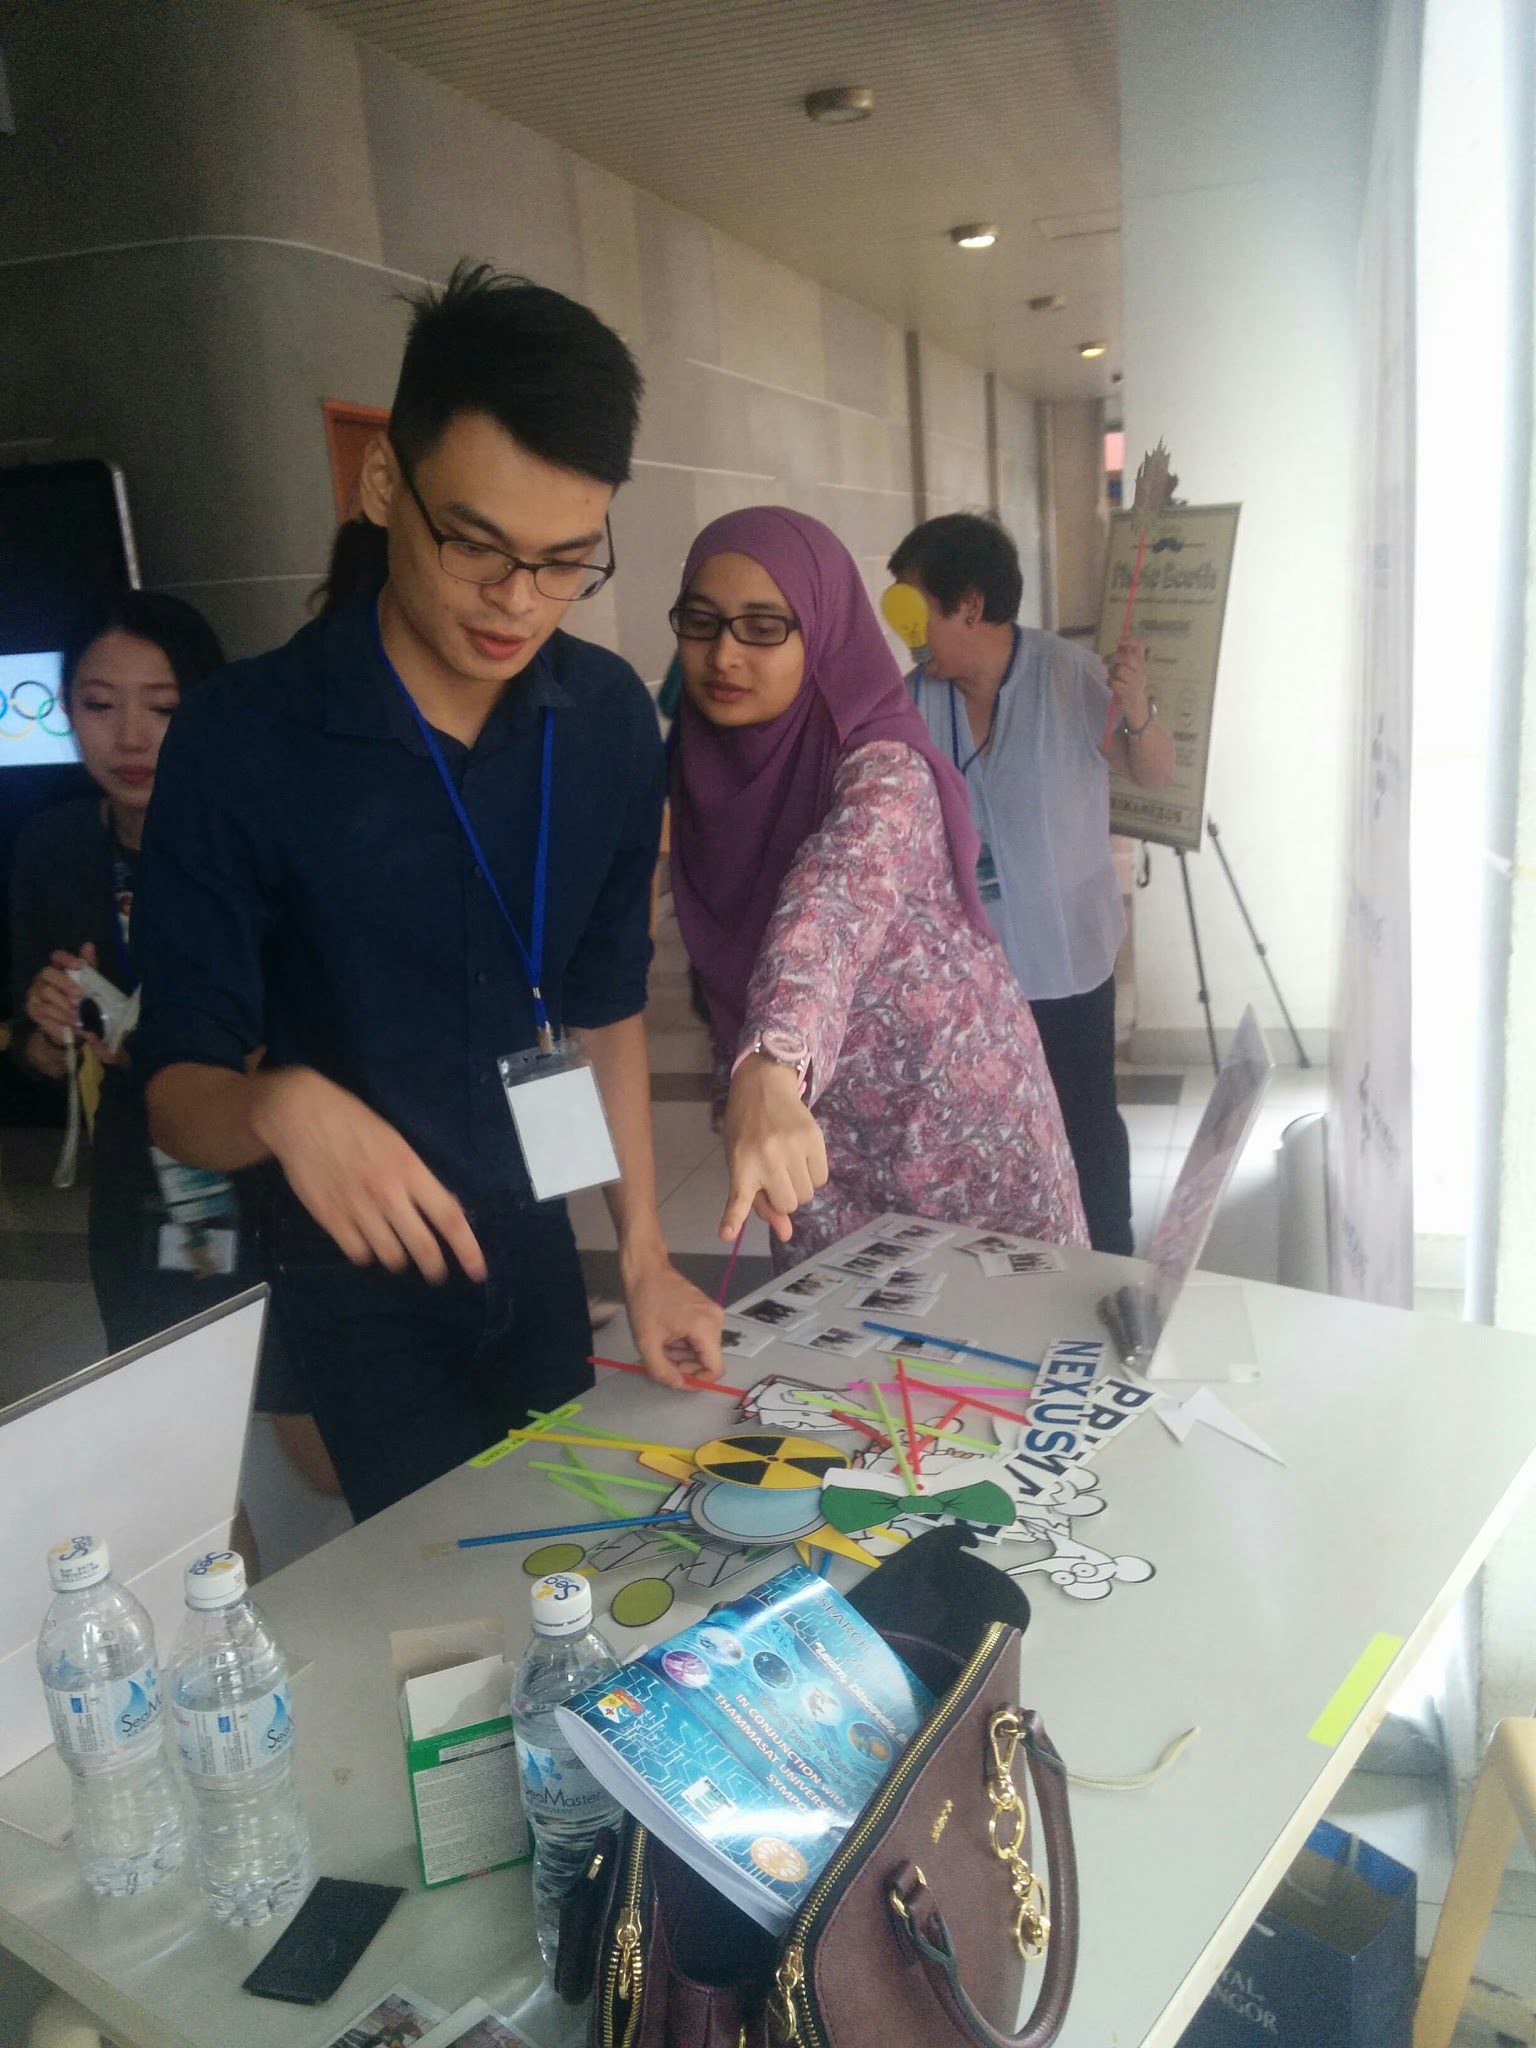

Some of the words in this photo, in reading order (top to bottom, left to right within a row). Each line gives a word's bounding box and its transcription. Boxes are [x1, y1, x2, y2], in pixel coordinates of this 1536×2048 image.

[1025, 1340, 1103, 1453] NEXUS
[543, 1576, 580, 1601] Sea
[715, 1693, 780, 1763] THAMMASAT
[780, 1764, 832, 1813] UNIVERS
[736, 1694, 751, 1708] IN
[749, 1708, 822, 1784] CONJUNCTION
[821, 1784, 848, 1809] with
